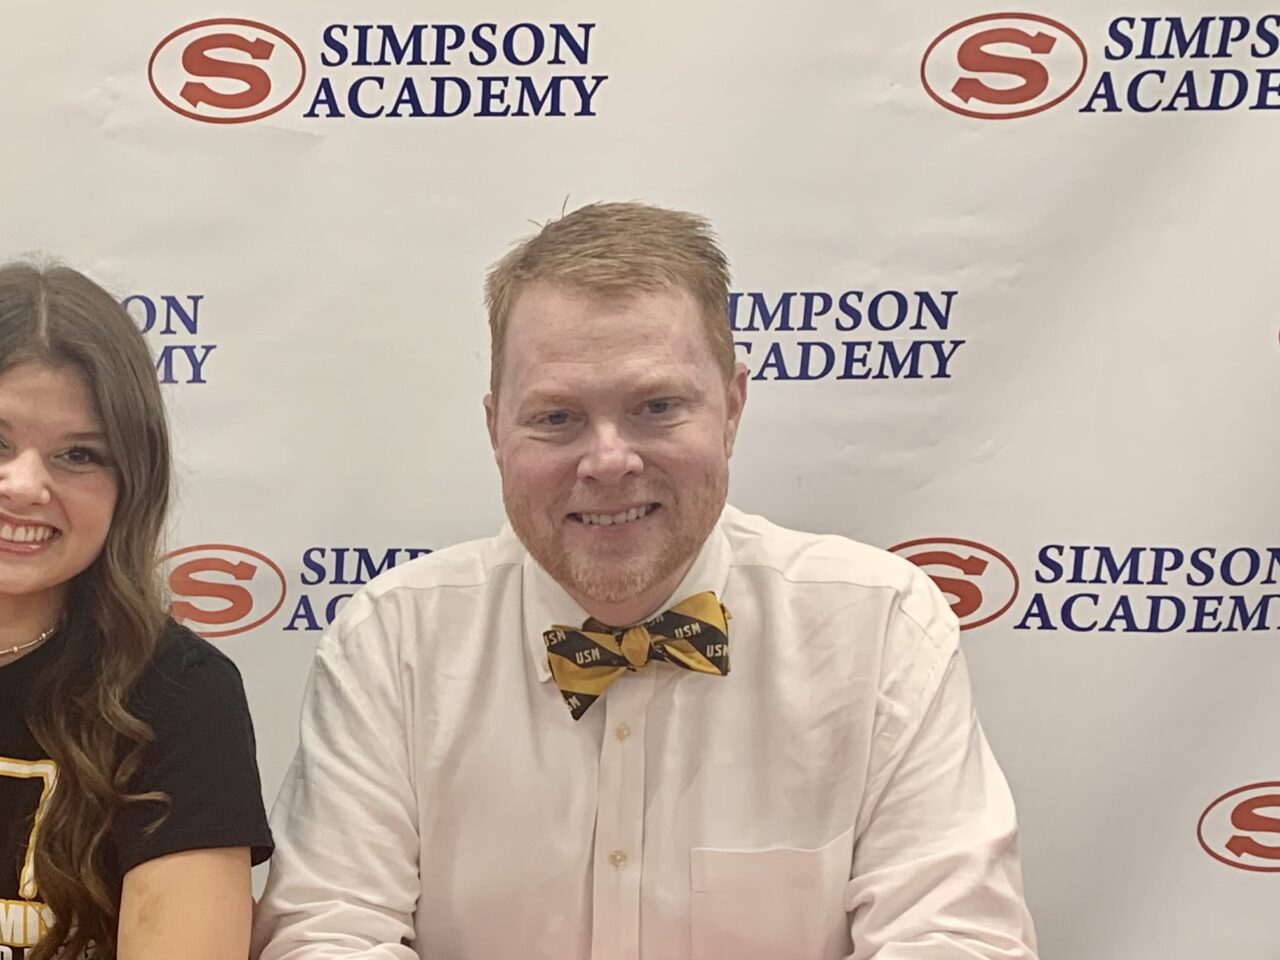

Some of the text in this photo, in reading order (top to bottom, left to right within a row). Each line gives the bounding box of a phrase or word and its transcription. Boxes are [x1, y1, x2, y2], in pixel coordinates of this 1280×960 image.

[320, 23, 596, 67] SIMPSON
[302, 75, 609, 118] ACADEMY
[674, 622, 702, 639] USM
[1013, 592, 1280, 634] ACADEM
[575, 647, 601, 665] USM
